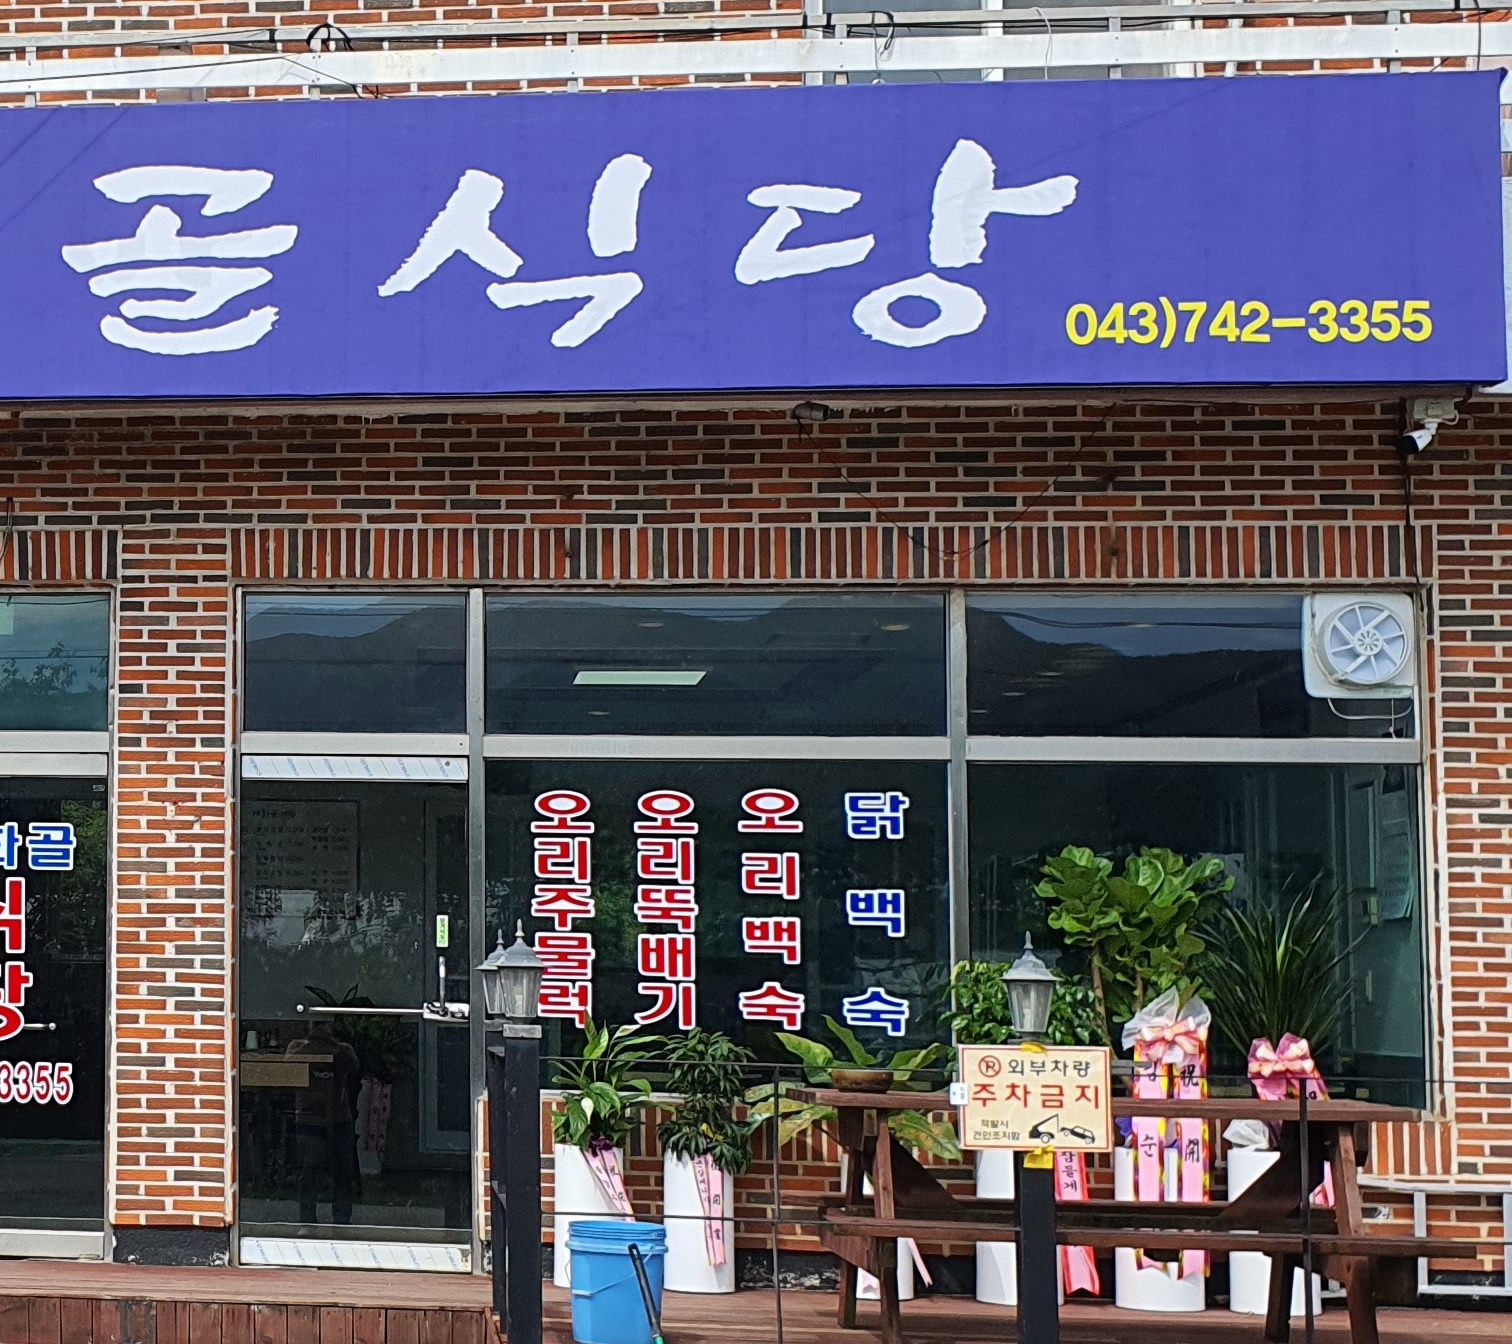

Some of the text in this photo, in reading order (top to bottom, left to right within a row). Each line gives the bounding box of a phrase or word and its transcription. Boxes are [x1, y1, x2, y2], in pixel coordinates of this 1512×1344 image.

[1066, 299, 1431, 347] 043)742-3355
[530, 790, 595, 1029] 오리주물럭
[633, 790, 699, 1030] 오리뚝배기
[737, 788, 805, 1031] 오리백숙
[843, 791, 910, 1037] 닭백숙
[971, 1082, 1100, 1110] 주차금지
[1007, 1059, 1091, 1078] 외부차량
